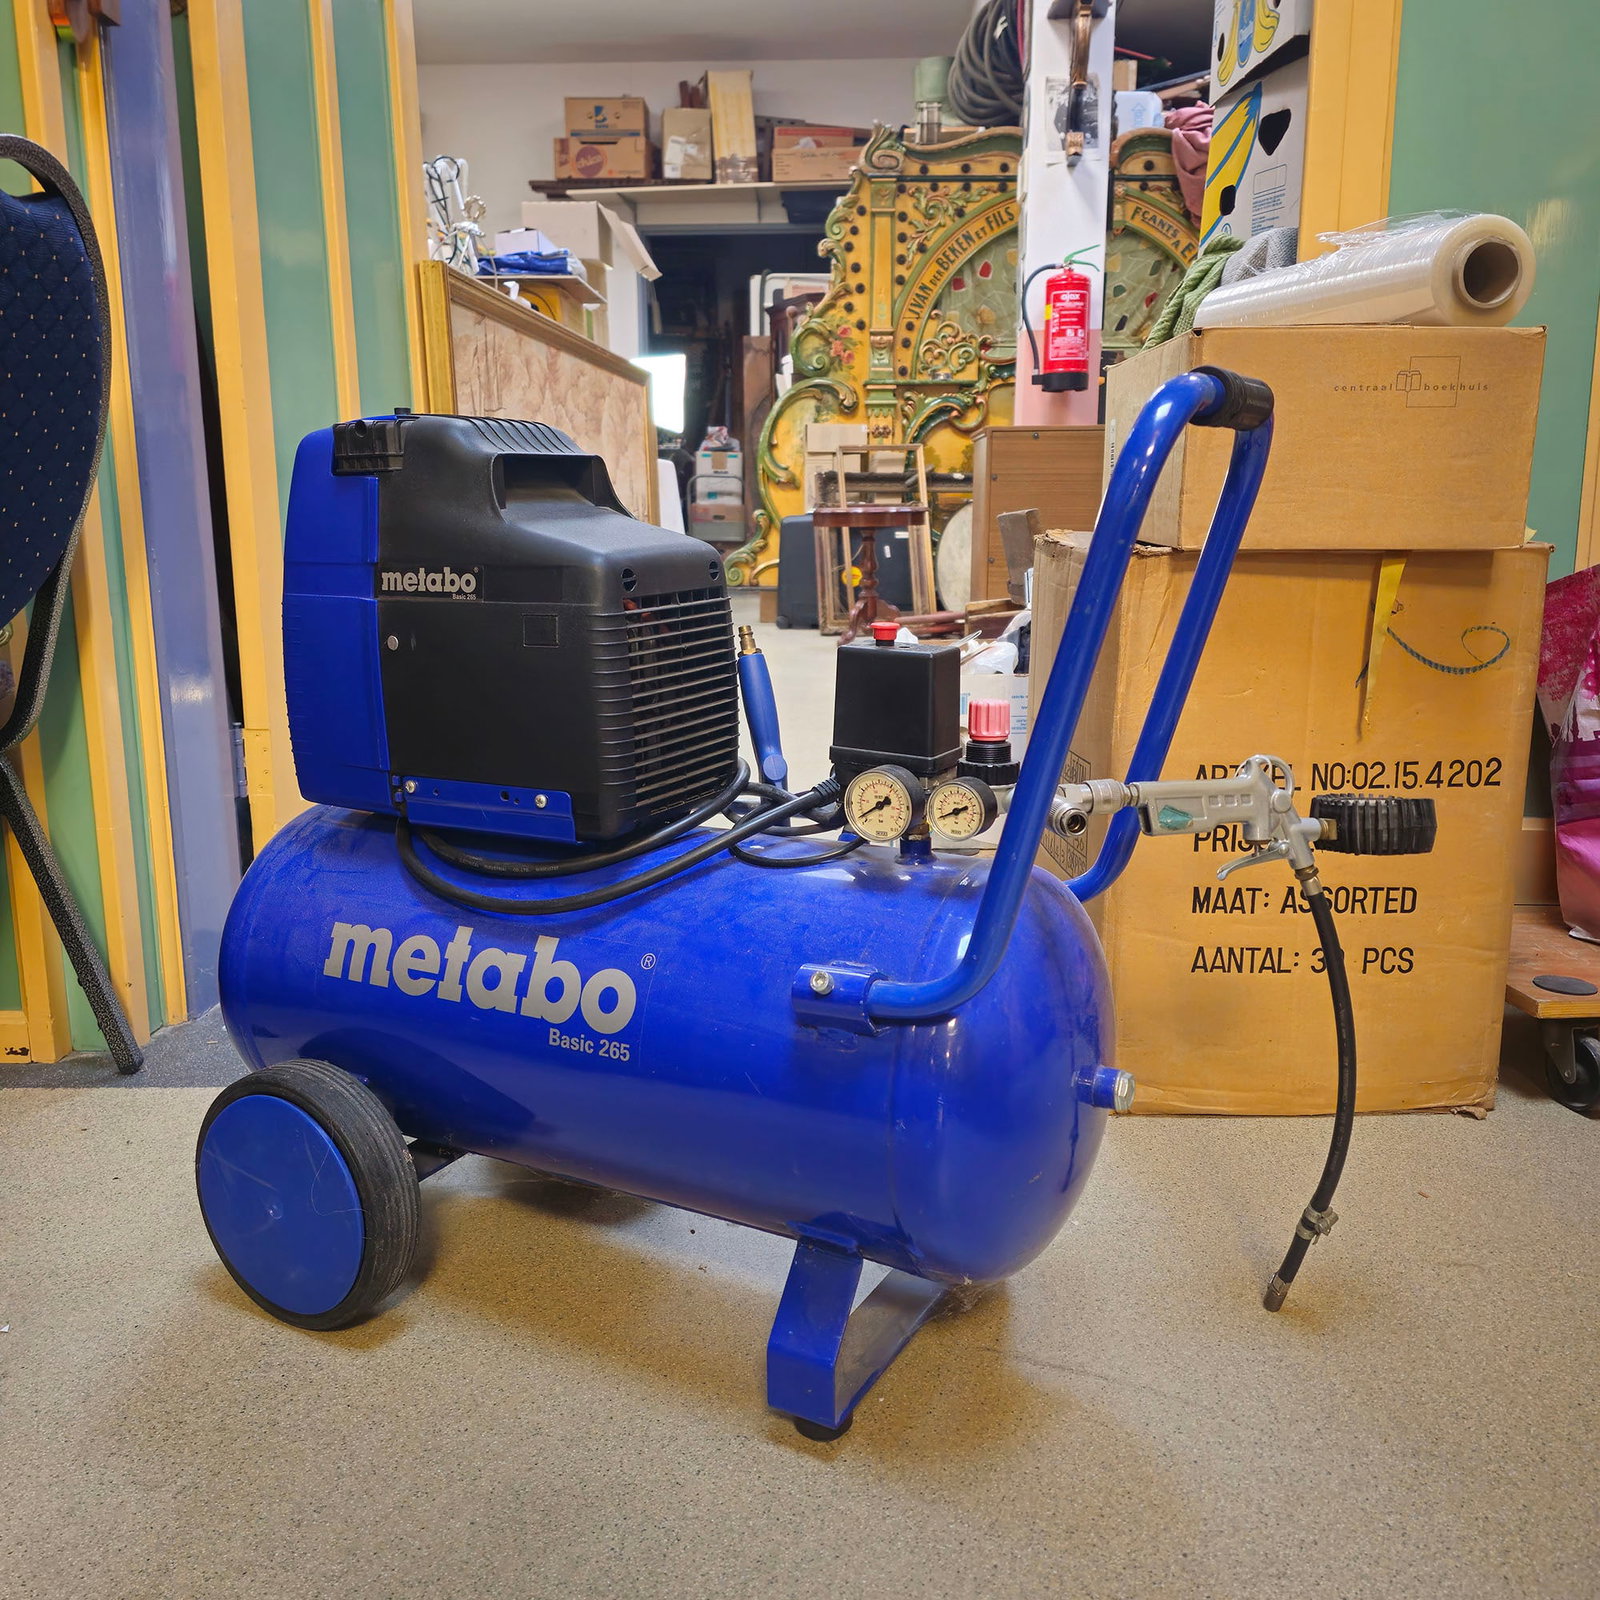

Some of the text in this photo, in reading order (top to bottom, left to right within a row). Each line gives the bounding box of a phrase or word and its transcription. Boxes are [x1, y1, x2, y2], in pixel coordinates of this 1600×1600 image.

[986, 206, 1016, 231] FILS
[974, 226, 988, 240] ET
[935, 230, 976, 272] BEKEN
[929, 269, 945, 286] DER
[1334, 383, 1488, 392] centraal boekhuis
[382, 567, 477, 593] metabo
[1191, 886, 1270, 915] MAAT:
[1190, 946, 1300, 974] AANTAL:
[1362, 947, 1415, 975] PCS
[323, 921, 637, 1035] metabo
[548, 1028, 631, 1062] Basic 265
